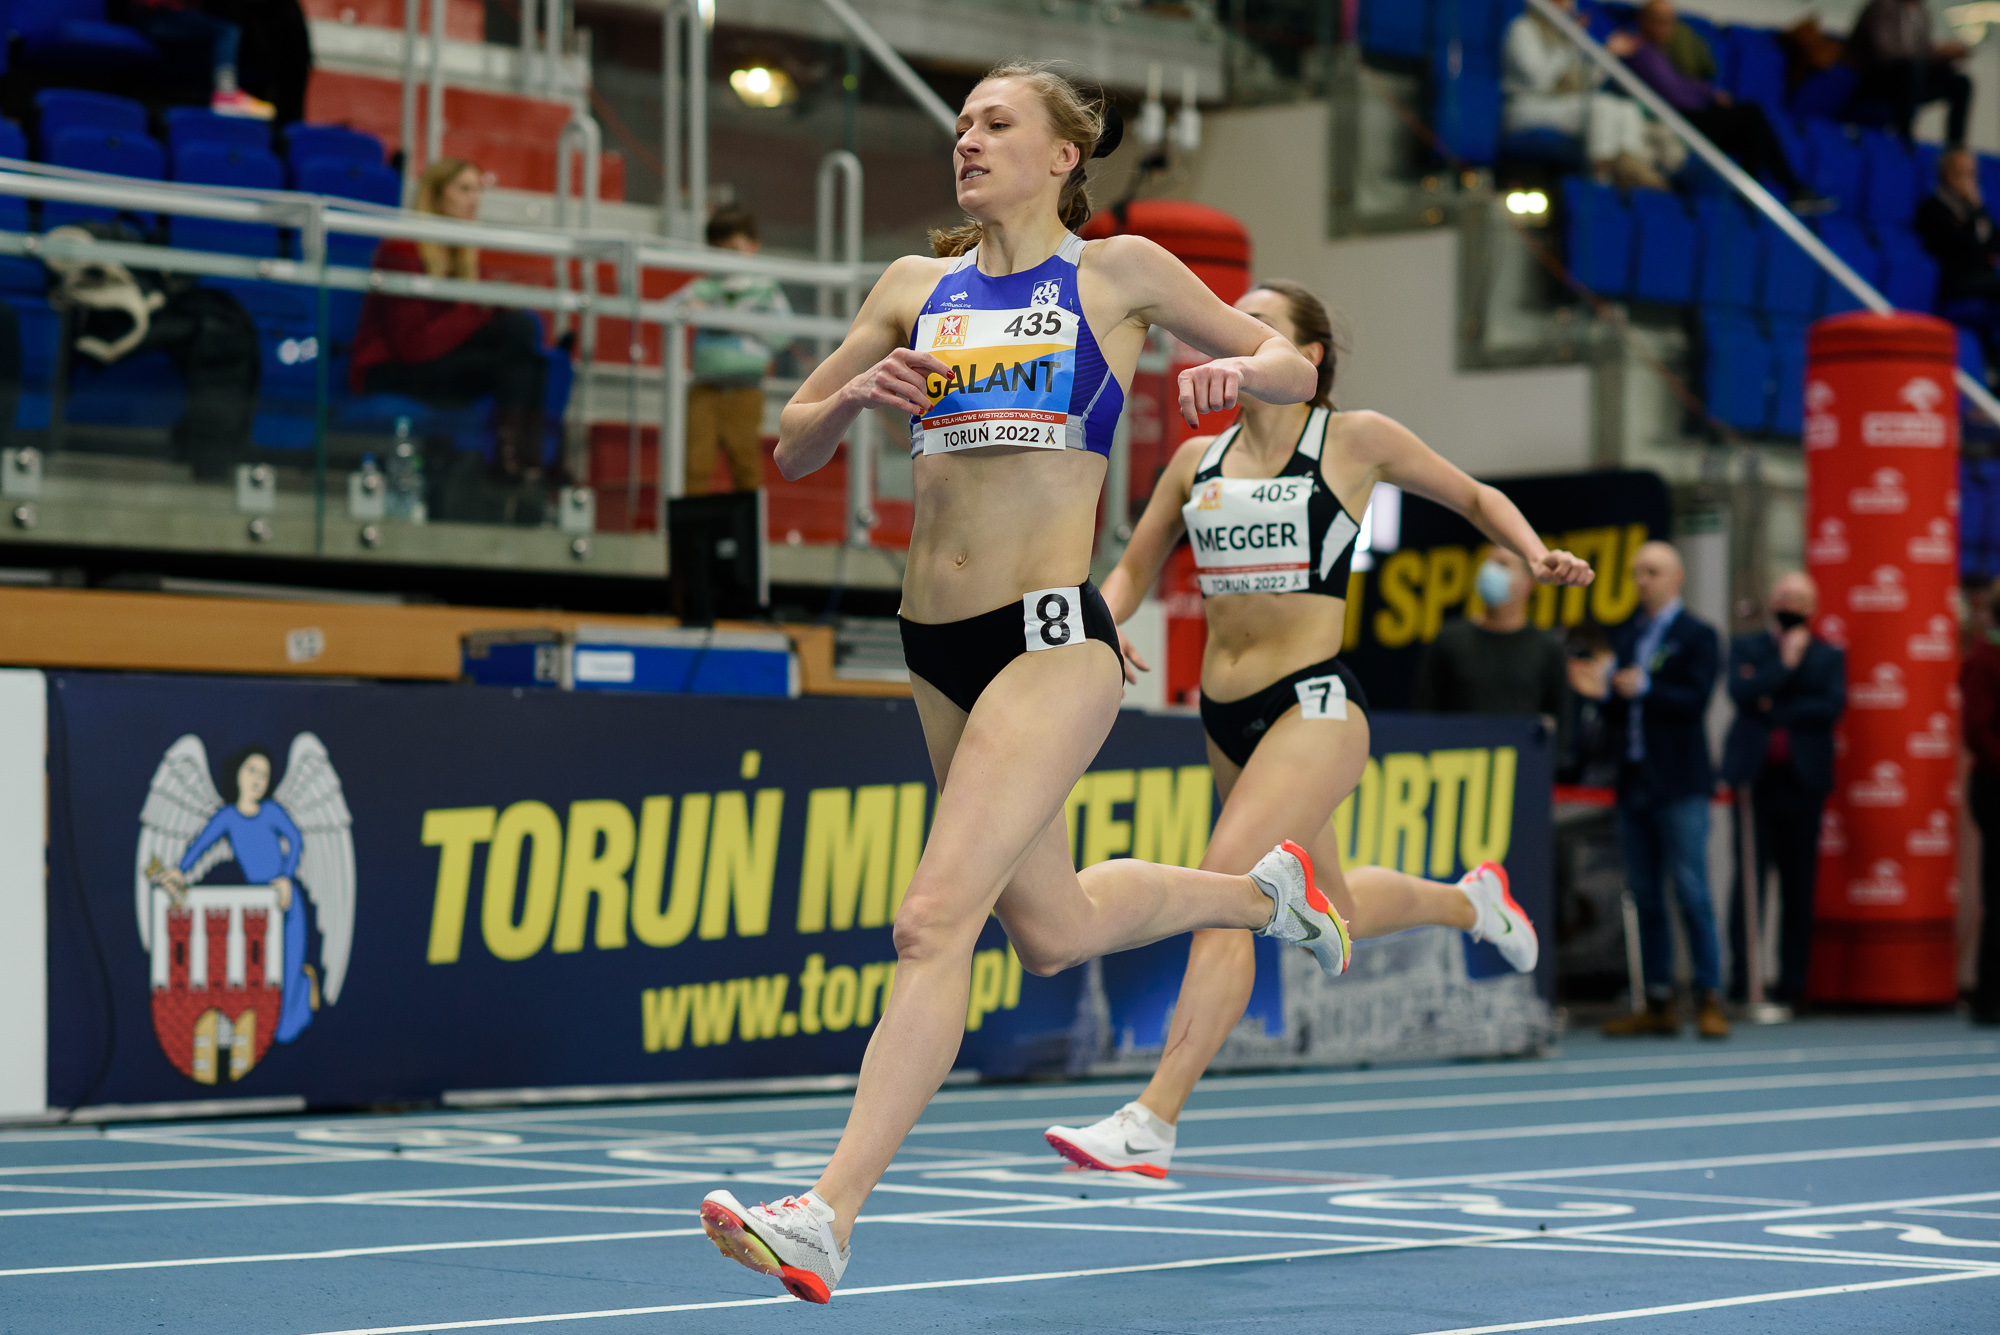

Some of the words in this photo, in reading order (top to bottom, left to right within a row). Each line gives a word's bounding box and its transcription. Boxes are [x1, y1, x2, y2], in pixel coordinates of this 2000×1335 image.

[1003, 310, 1062, 337] 435
[934, 336, 964, 346] PZLA
[926, 360, 1062, 399] GALANT
[942, 417, 955, 425] PZLA
[955, 415, 977, 423] HALOWE
[978, 411, 1029, 420] MISTRZOSTWA
[1030, 413, 1055, 421] POLSKI
[943, 422, 989, 447] TORUŃ
[994, 425, 1040, 443] 2022
[1251, 484, 1299, 503] 405
[1195, 522, 1298, 552] MEGGER
[1212, 574, 1250, 592] TORUŃ
[1255, 576, 1287, 591] 2022
[1036, 593, 1071, 646] 8
[1308, 681, 1331, 714] 7
[421, 750, 785, 965] TORUŃ
